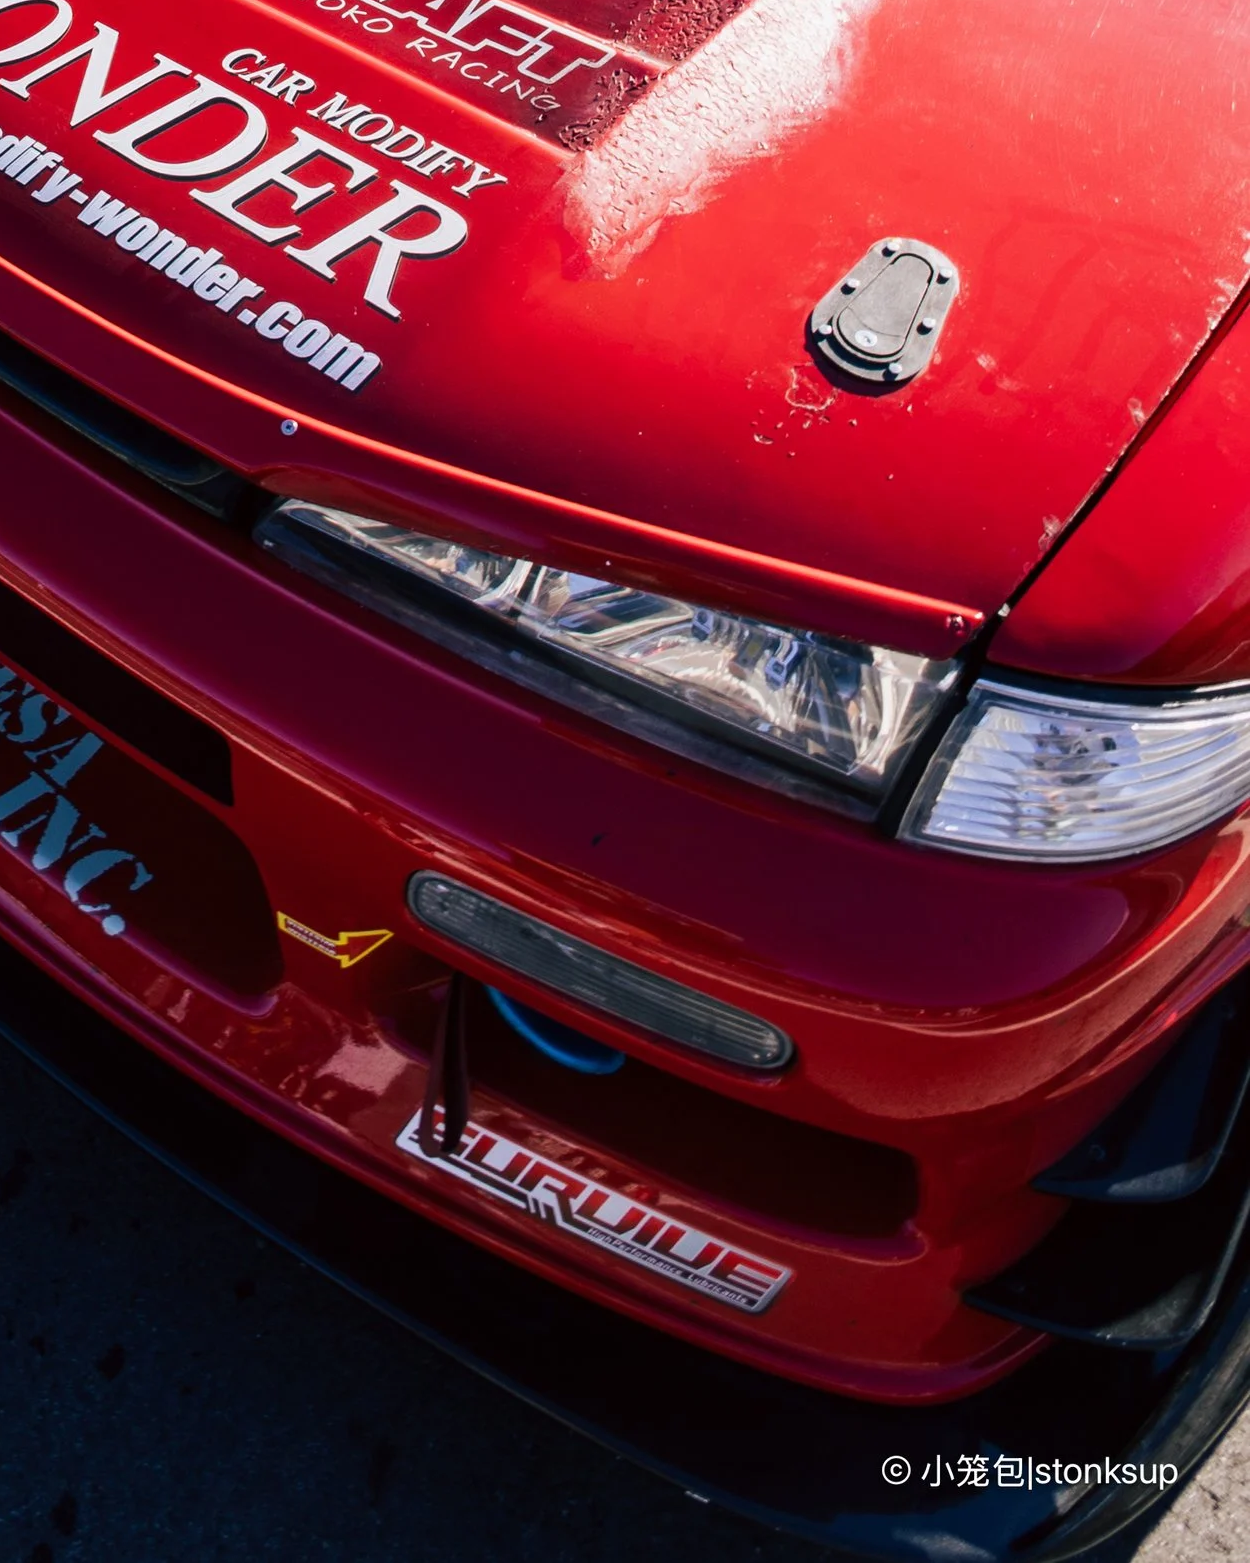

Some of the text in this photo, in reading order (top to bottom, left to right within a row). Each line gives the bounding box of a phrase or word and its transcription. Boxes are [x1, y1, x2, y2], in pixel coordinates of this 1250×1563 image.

[404, 36, 561, 112] RACING
[221, 48, 509, 198] CAR MODIFY
[687, 1271, 749, 1306] Lubricants
